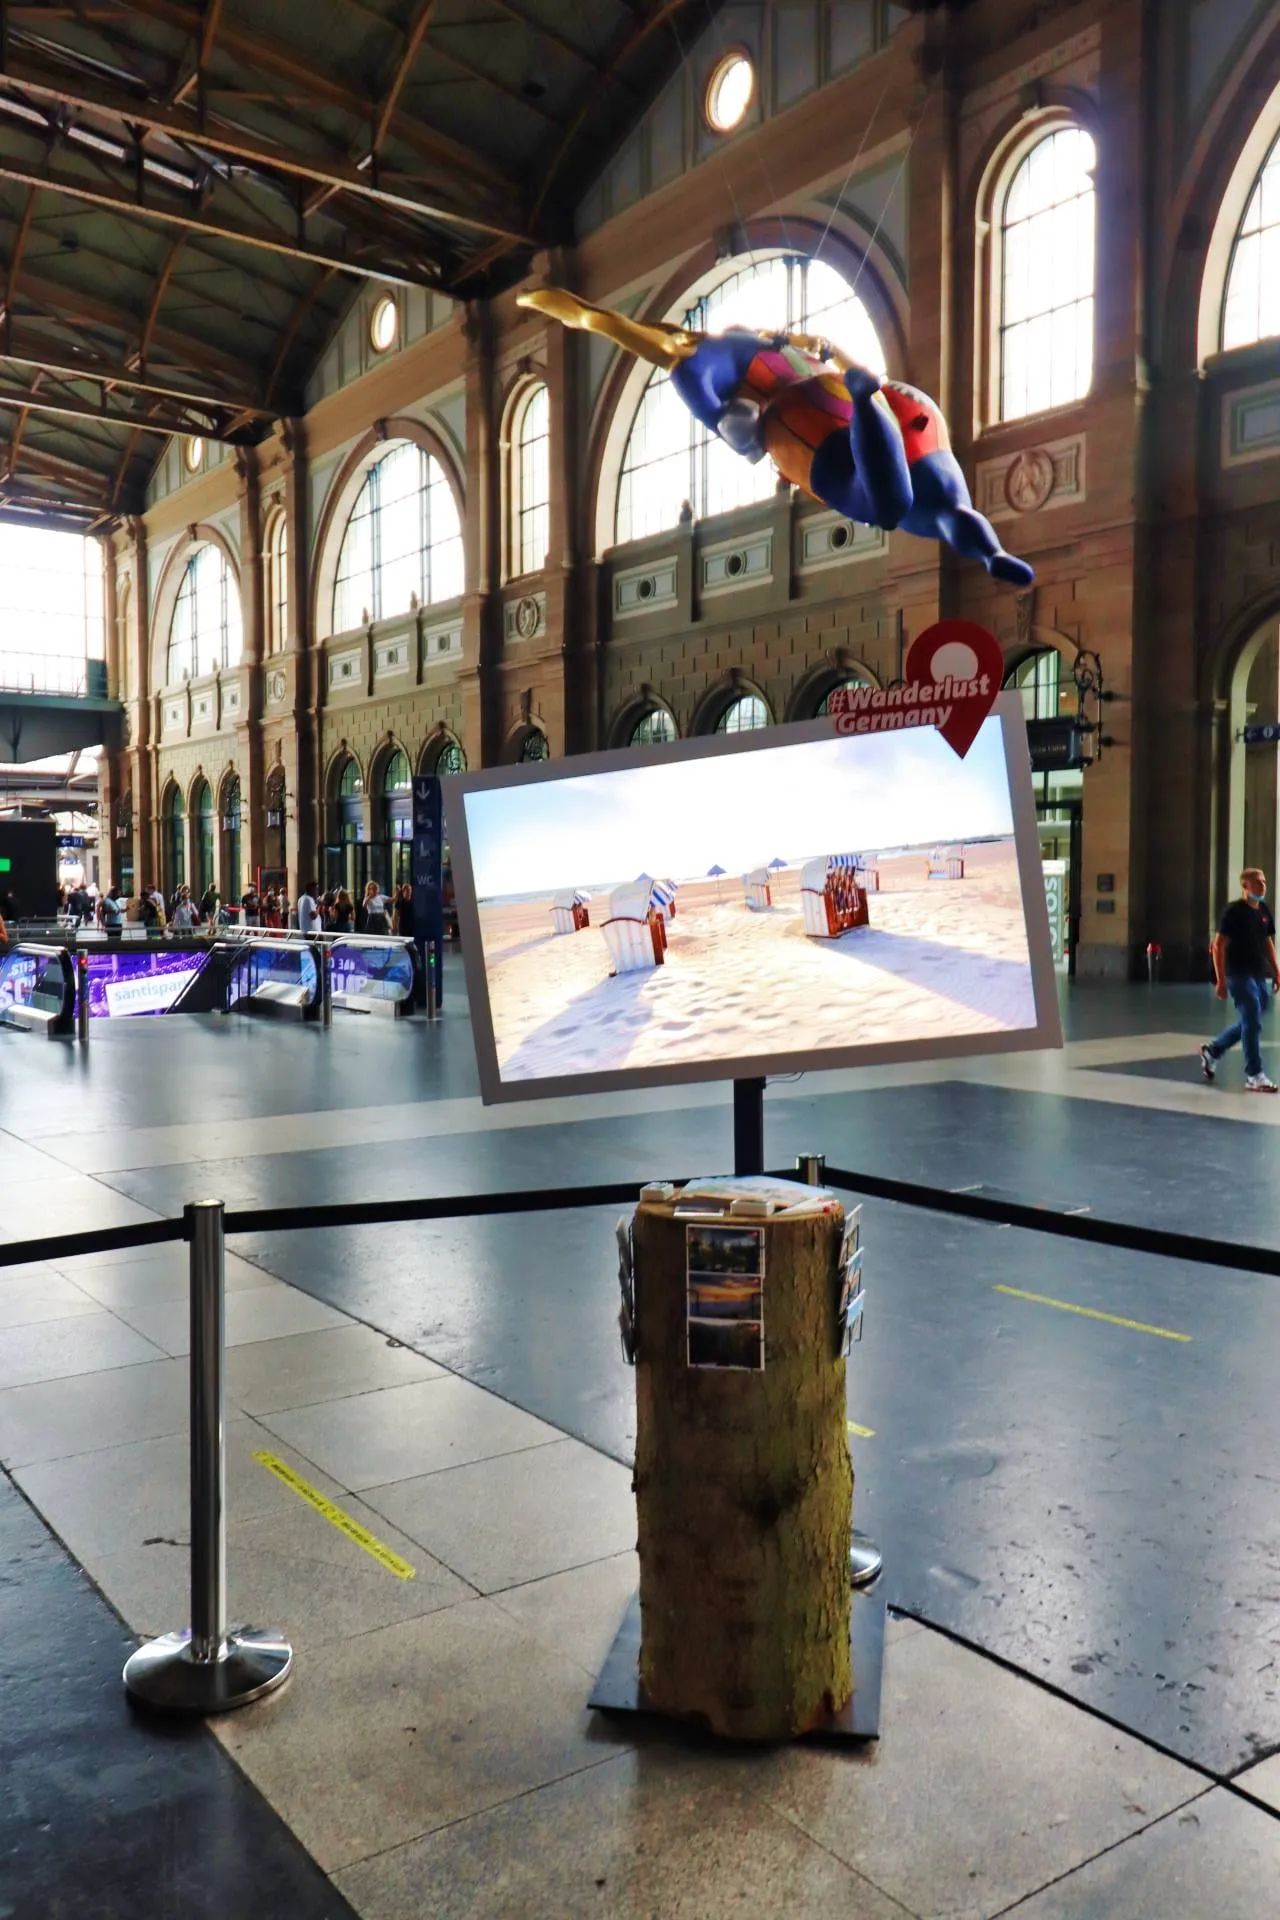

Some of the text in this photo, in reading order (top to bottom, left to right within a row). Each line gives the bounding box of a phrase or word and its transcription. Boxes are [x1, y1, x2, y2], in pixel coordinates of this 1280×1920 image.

[830, 673, 991, 713] #Wanderlust
[837, 705, 953, 733] Germany
[416, 874, 434, 885] WC
